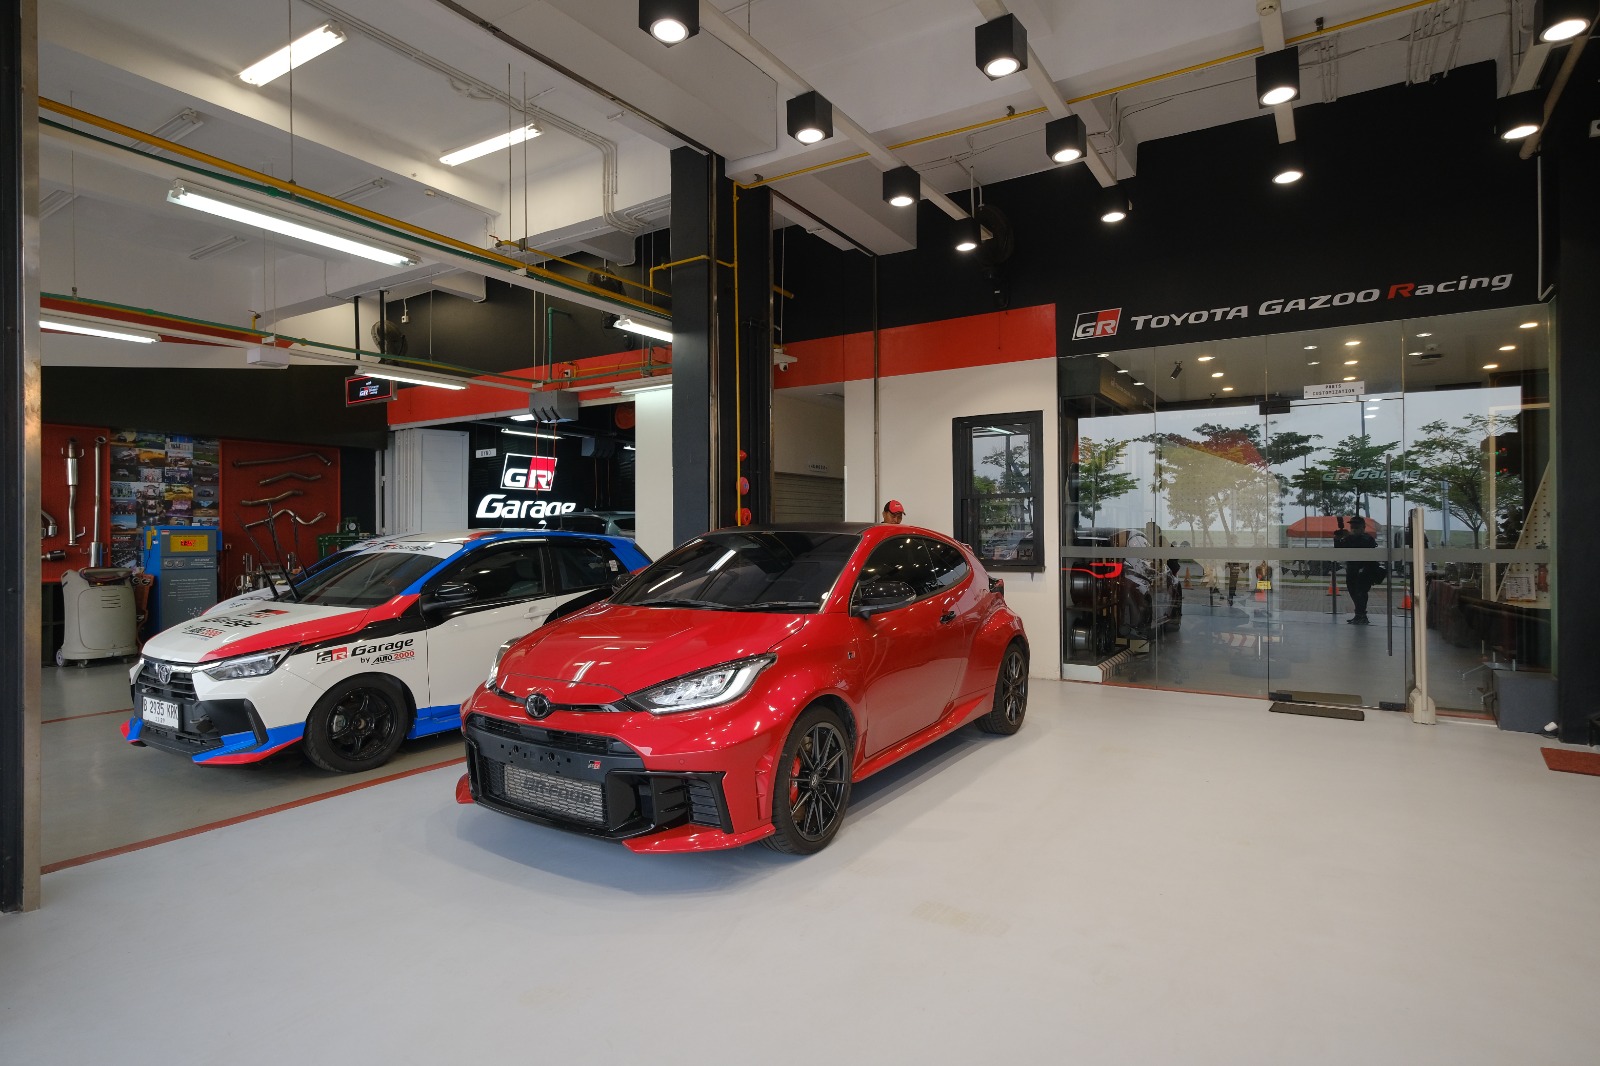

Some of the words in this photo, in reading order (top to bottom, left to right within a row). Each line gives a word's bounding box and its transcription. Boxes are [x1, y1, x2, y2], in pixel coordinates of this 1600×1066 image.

[1075, 317, 1118, 339] GR
[1130, 305, 1249, 331] TOYOTA
[1258, 288, 1380, 316] GAZOO
[1387, 273, 1513, 300] Racing
[1312, 388, 1355, 396] CUSTOMIZATION
[503, 465, 553, 489] GR
[1322, 469, 1350, 481] GR
[475, 493, 577, 524] Garage
[350, 638, 414, 657] Garage
[360, 656, 371, 664] by
[143, 699, 148, 712] B
